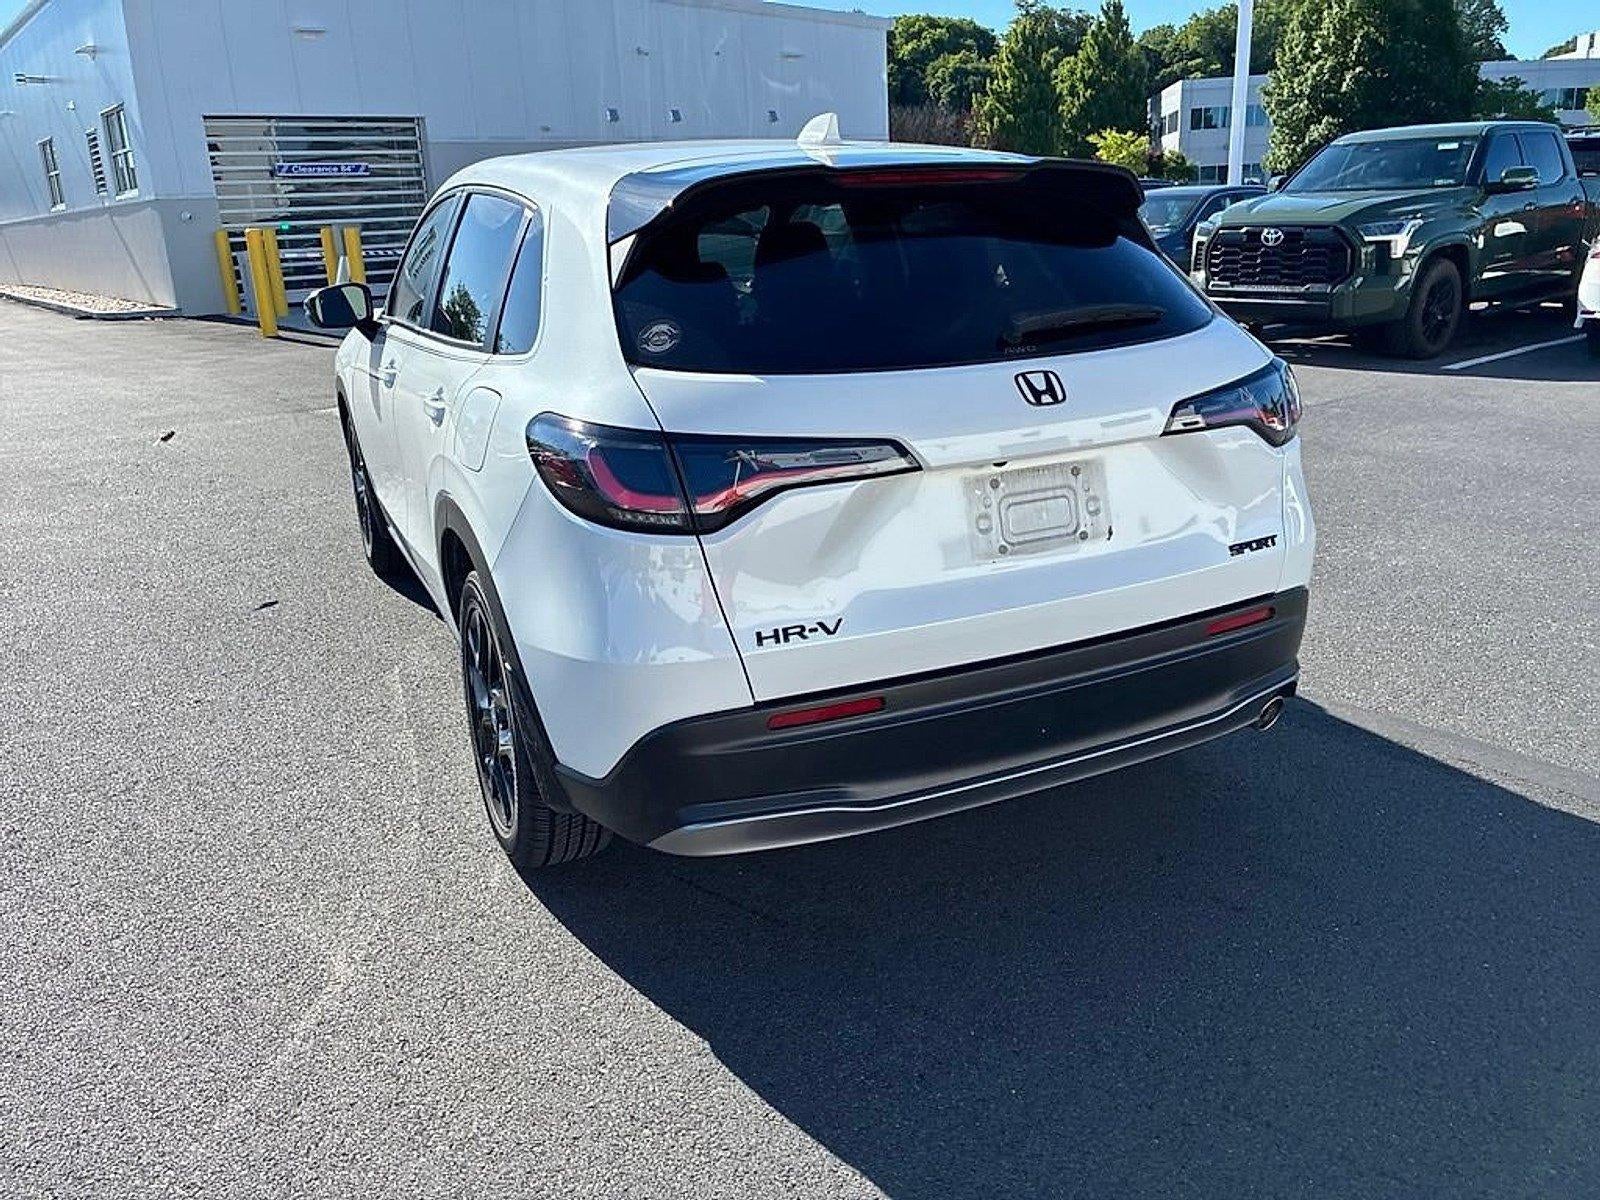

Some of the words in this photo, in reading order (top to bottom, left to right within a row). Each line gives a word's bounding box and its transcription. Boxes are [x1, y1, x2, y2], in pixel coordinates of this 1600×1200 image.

[292, 165, 339, 174] Clearance
[1228, 534, 1277, 556] SPORT
[755, 617, 843, 647] HR-V
